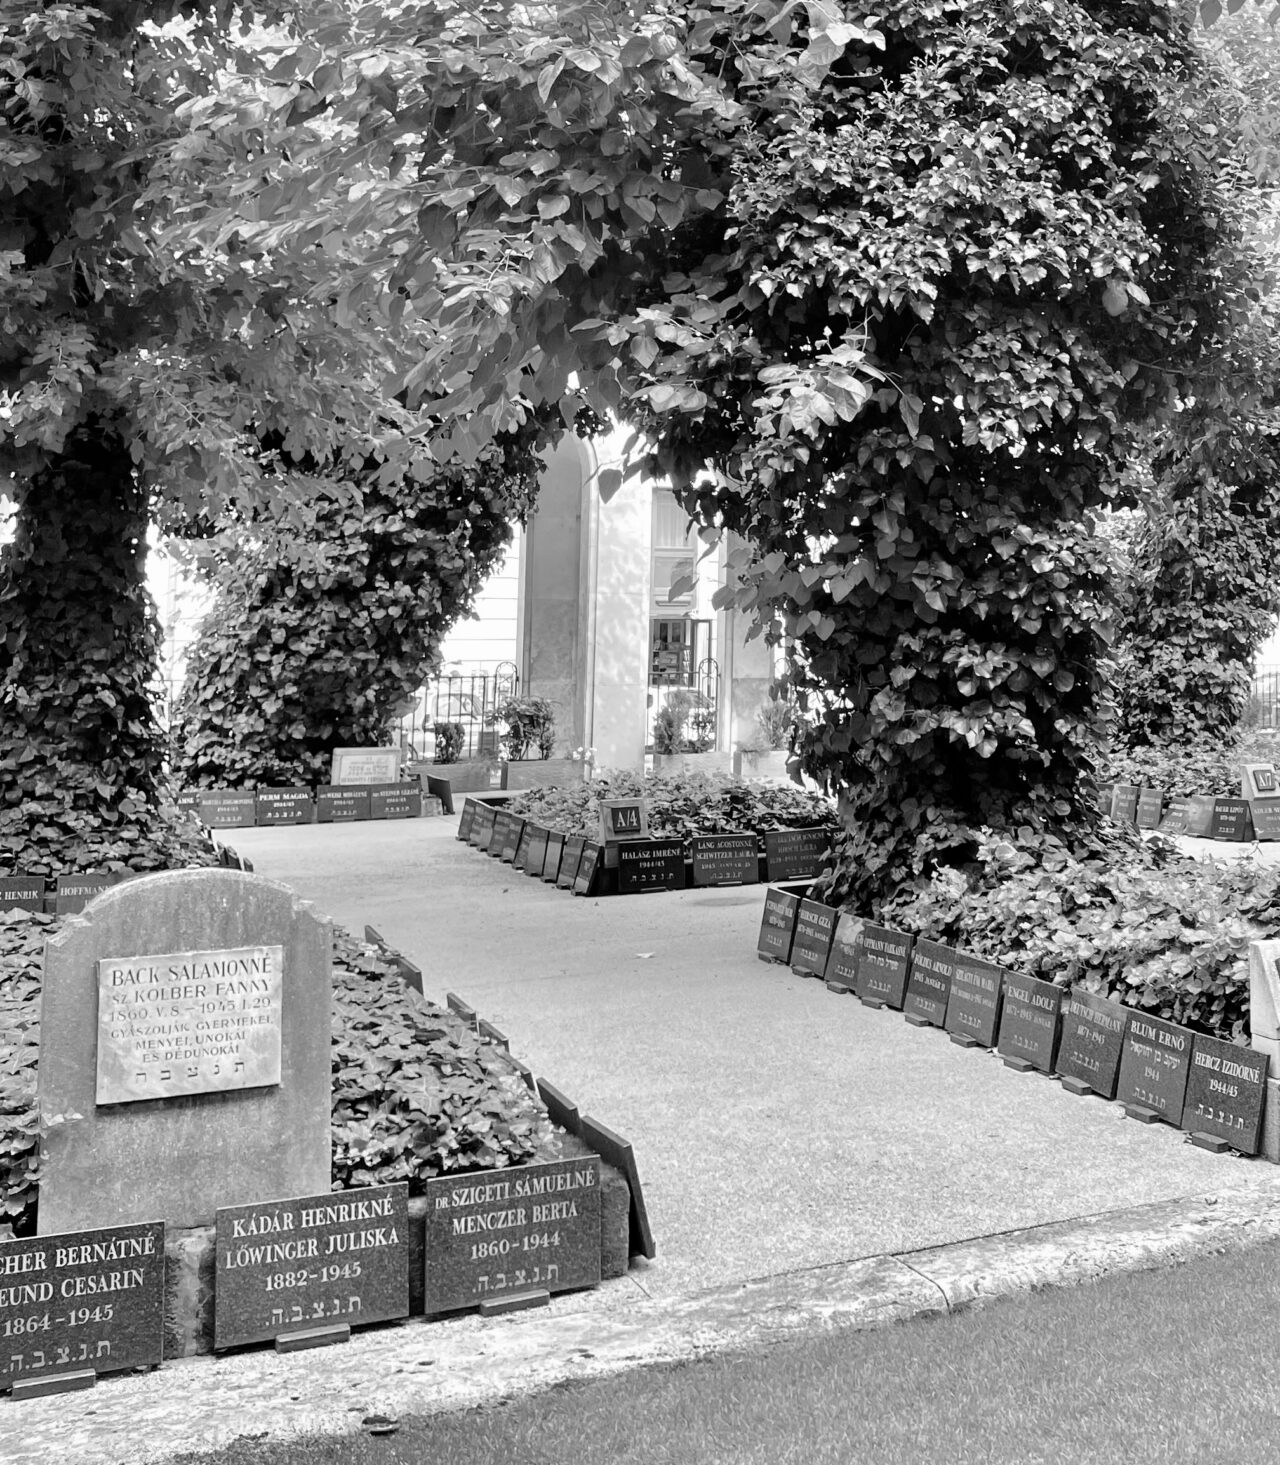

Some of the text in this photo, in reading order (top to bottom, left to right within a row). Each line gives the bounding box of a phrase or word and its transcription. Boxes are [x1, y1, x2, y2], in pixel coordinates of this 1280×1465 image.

[1259, 773, 1272, 787] A/7
[617, 810, 637, 827] A/4
[622, 848, 681, 859] HALÁSZ IMRÉNÉ
[4, 890, 38, 900] HENRIK
[60, 885, 110, 896] HOFFMAN
[112, 953, 271, 986] BACK SALAMONNÉ
[135, 985, 206, 1003] KOLBER
[216, 979, 271, 996] FANNY
[1008, 986, 1029, 1003] ENGEL
[1031, 994, 1055, 1011] ADOLF
[111, 1020, 190, 1039] GYÁSZOLJÁK
[195, 1029, 245, 1045] UNOKÁI
[1130, 1020, 1185, 1051] BLUM ERNŐ
[165, 1044, 240, 1060] DÉDUNOKÁI
[1144, 1066, 1160, 1082] 1944
[1194, 1052, 1260, 1083] HERCZ IZIDORNÉ
[1208, 1078, 1238, 1098] 1944/45
[436, 1165, 595, 1209] DR SZIGETI SÁMUELNÉ
[232, 1194, 394, 1238] KÁDÁR HENRIKNÉ
[452, 1200, 578, 1235] MENCZER BERTA
[56, 1232, 155, 1267] BERNÁTNÉ
[226, 1227, 399, 1269] LŐWINGER JULISKA
[470, 1231, 560, 1259] 1860-1944
[61, 1268, 144, 1297] CESARIN
[266, 1261, 361, 1291] 1882-1945
